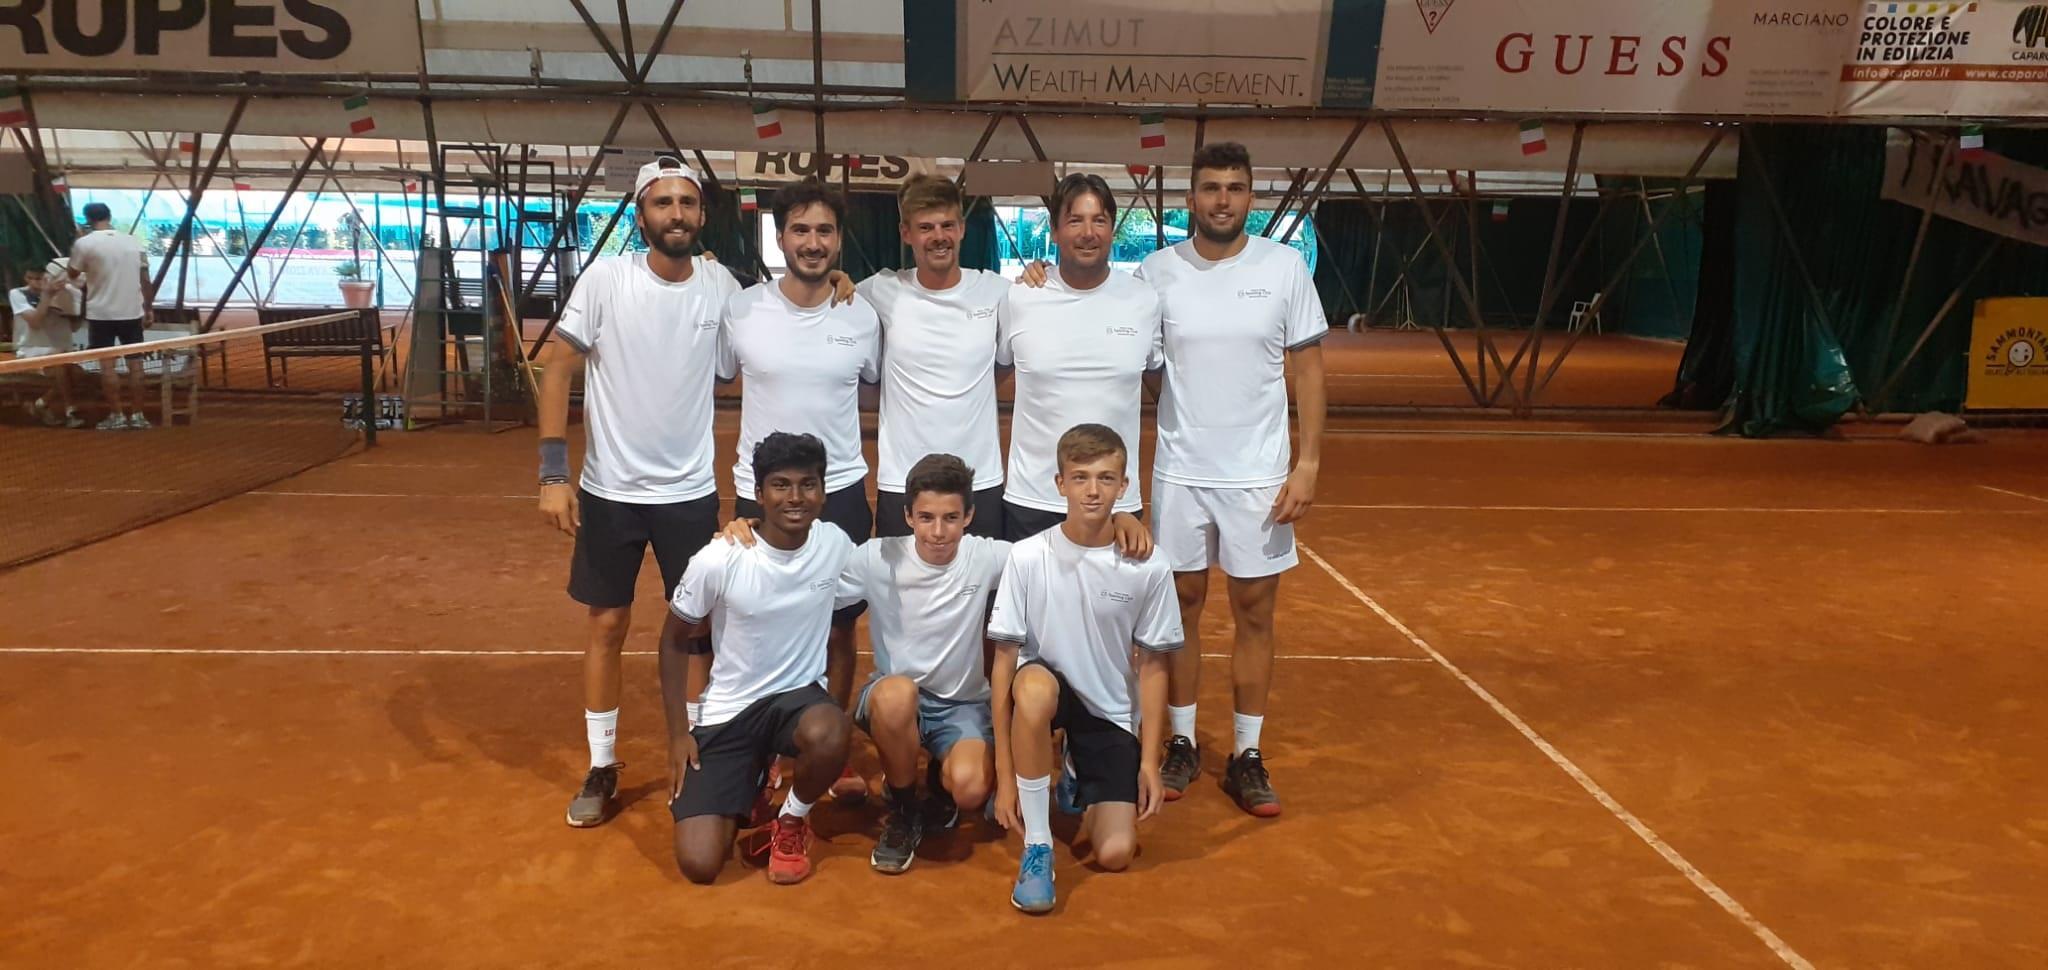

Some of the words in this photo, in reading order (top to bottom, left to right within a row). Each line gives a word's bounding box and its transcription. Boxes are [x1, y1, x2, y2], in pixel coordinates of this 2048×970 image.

[1753, 12, 1849, 27] MARCIANO
[1864, 16, 1935, 31] COLORE
[1941, 16, 1951, 30] E
[993, 17, 1145, 47] AZIMUT
[1859, 31, 1971, 46] PROTEZIONE
[1494, 32, 1732, 77] GUESS
[1856, 47, 1876, 61] IN
[1882, 46, 1954, 61] EDILIZIA
[993, 63, 1098, 93] WEALTH
[1105, 64, 1303, 97] MANAGEMENT.
